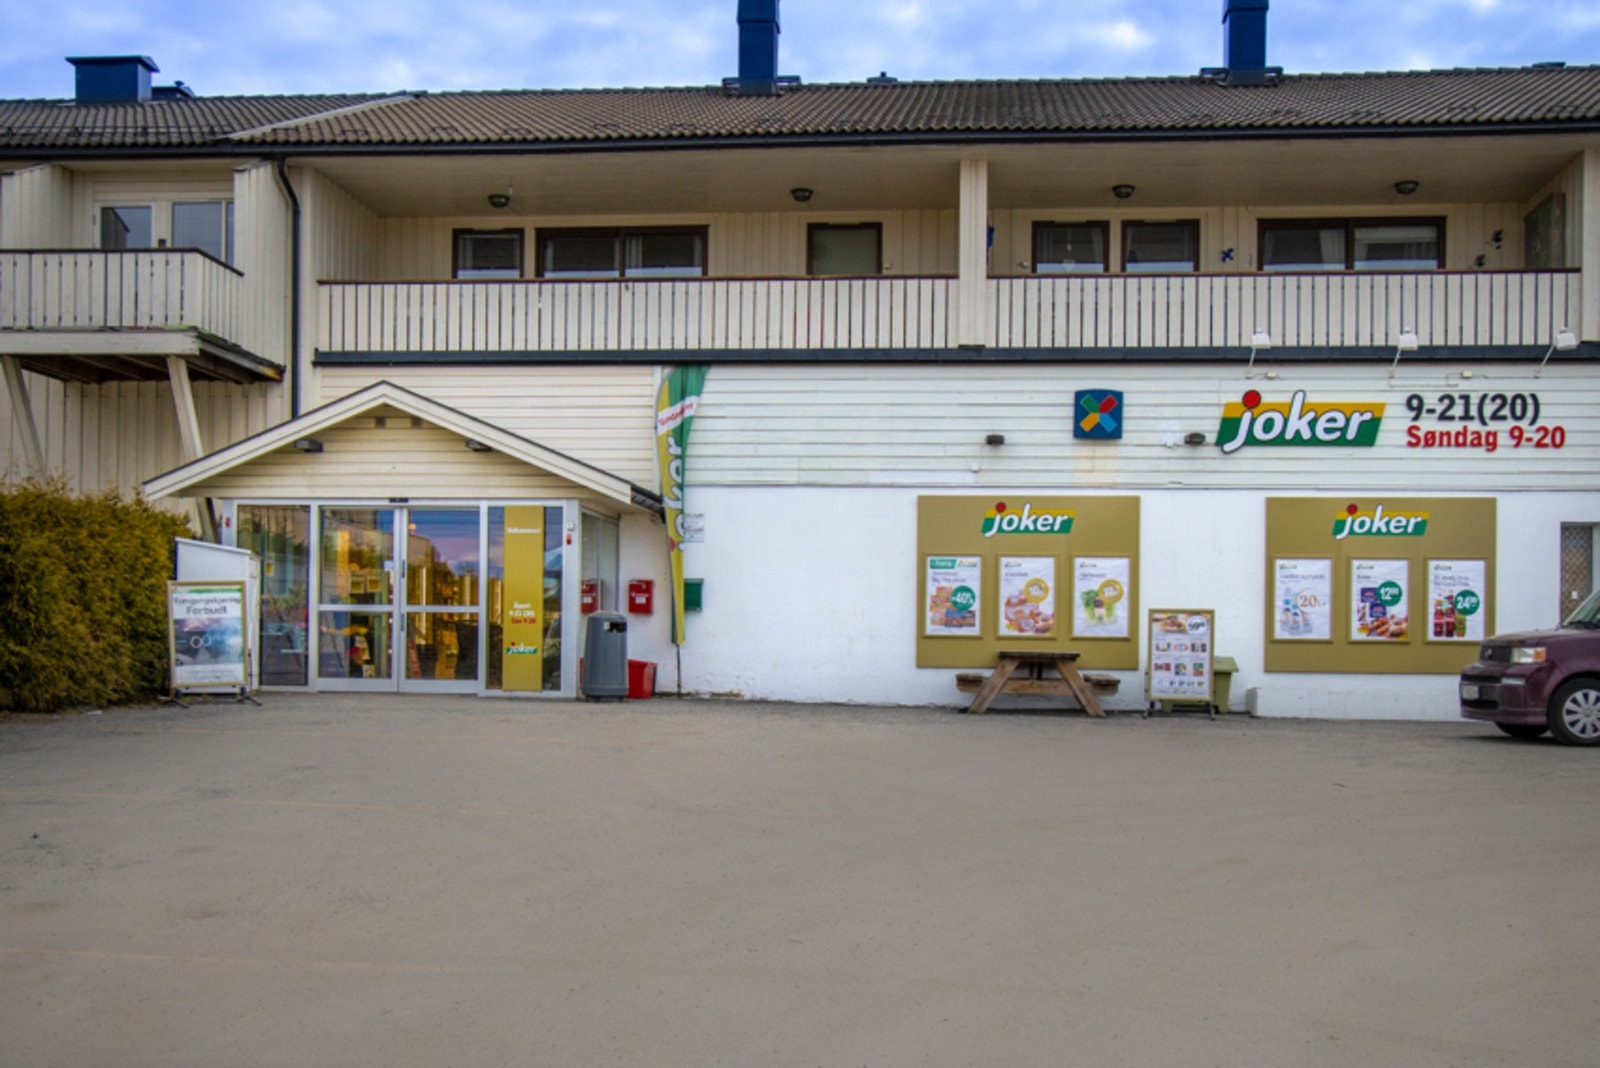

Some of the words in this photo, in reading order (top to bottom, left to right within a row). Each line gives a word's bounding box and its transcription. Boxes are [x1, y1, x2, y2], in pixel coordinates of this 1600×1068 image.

[1222, 389, 1374, 453] joker
[1405, 393, 1541, 425] 9-21(20)
[1405, 424, 1499, 451] Søndag
[1509, 425, 1566, 449] 9-20
[984, 501, 1069, 539] joker
[1334, 503, 1423, 540] joker
[186, 605, 228, 615] Forbudt
